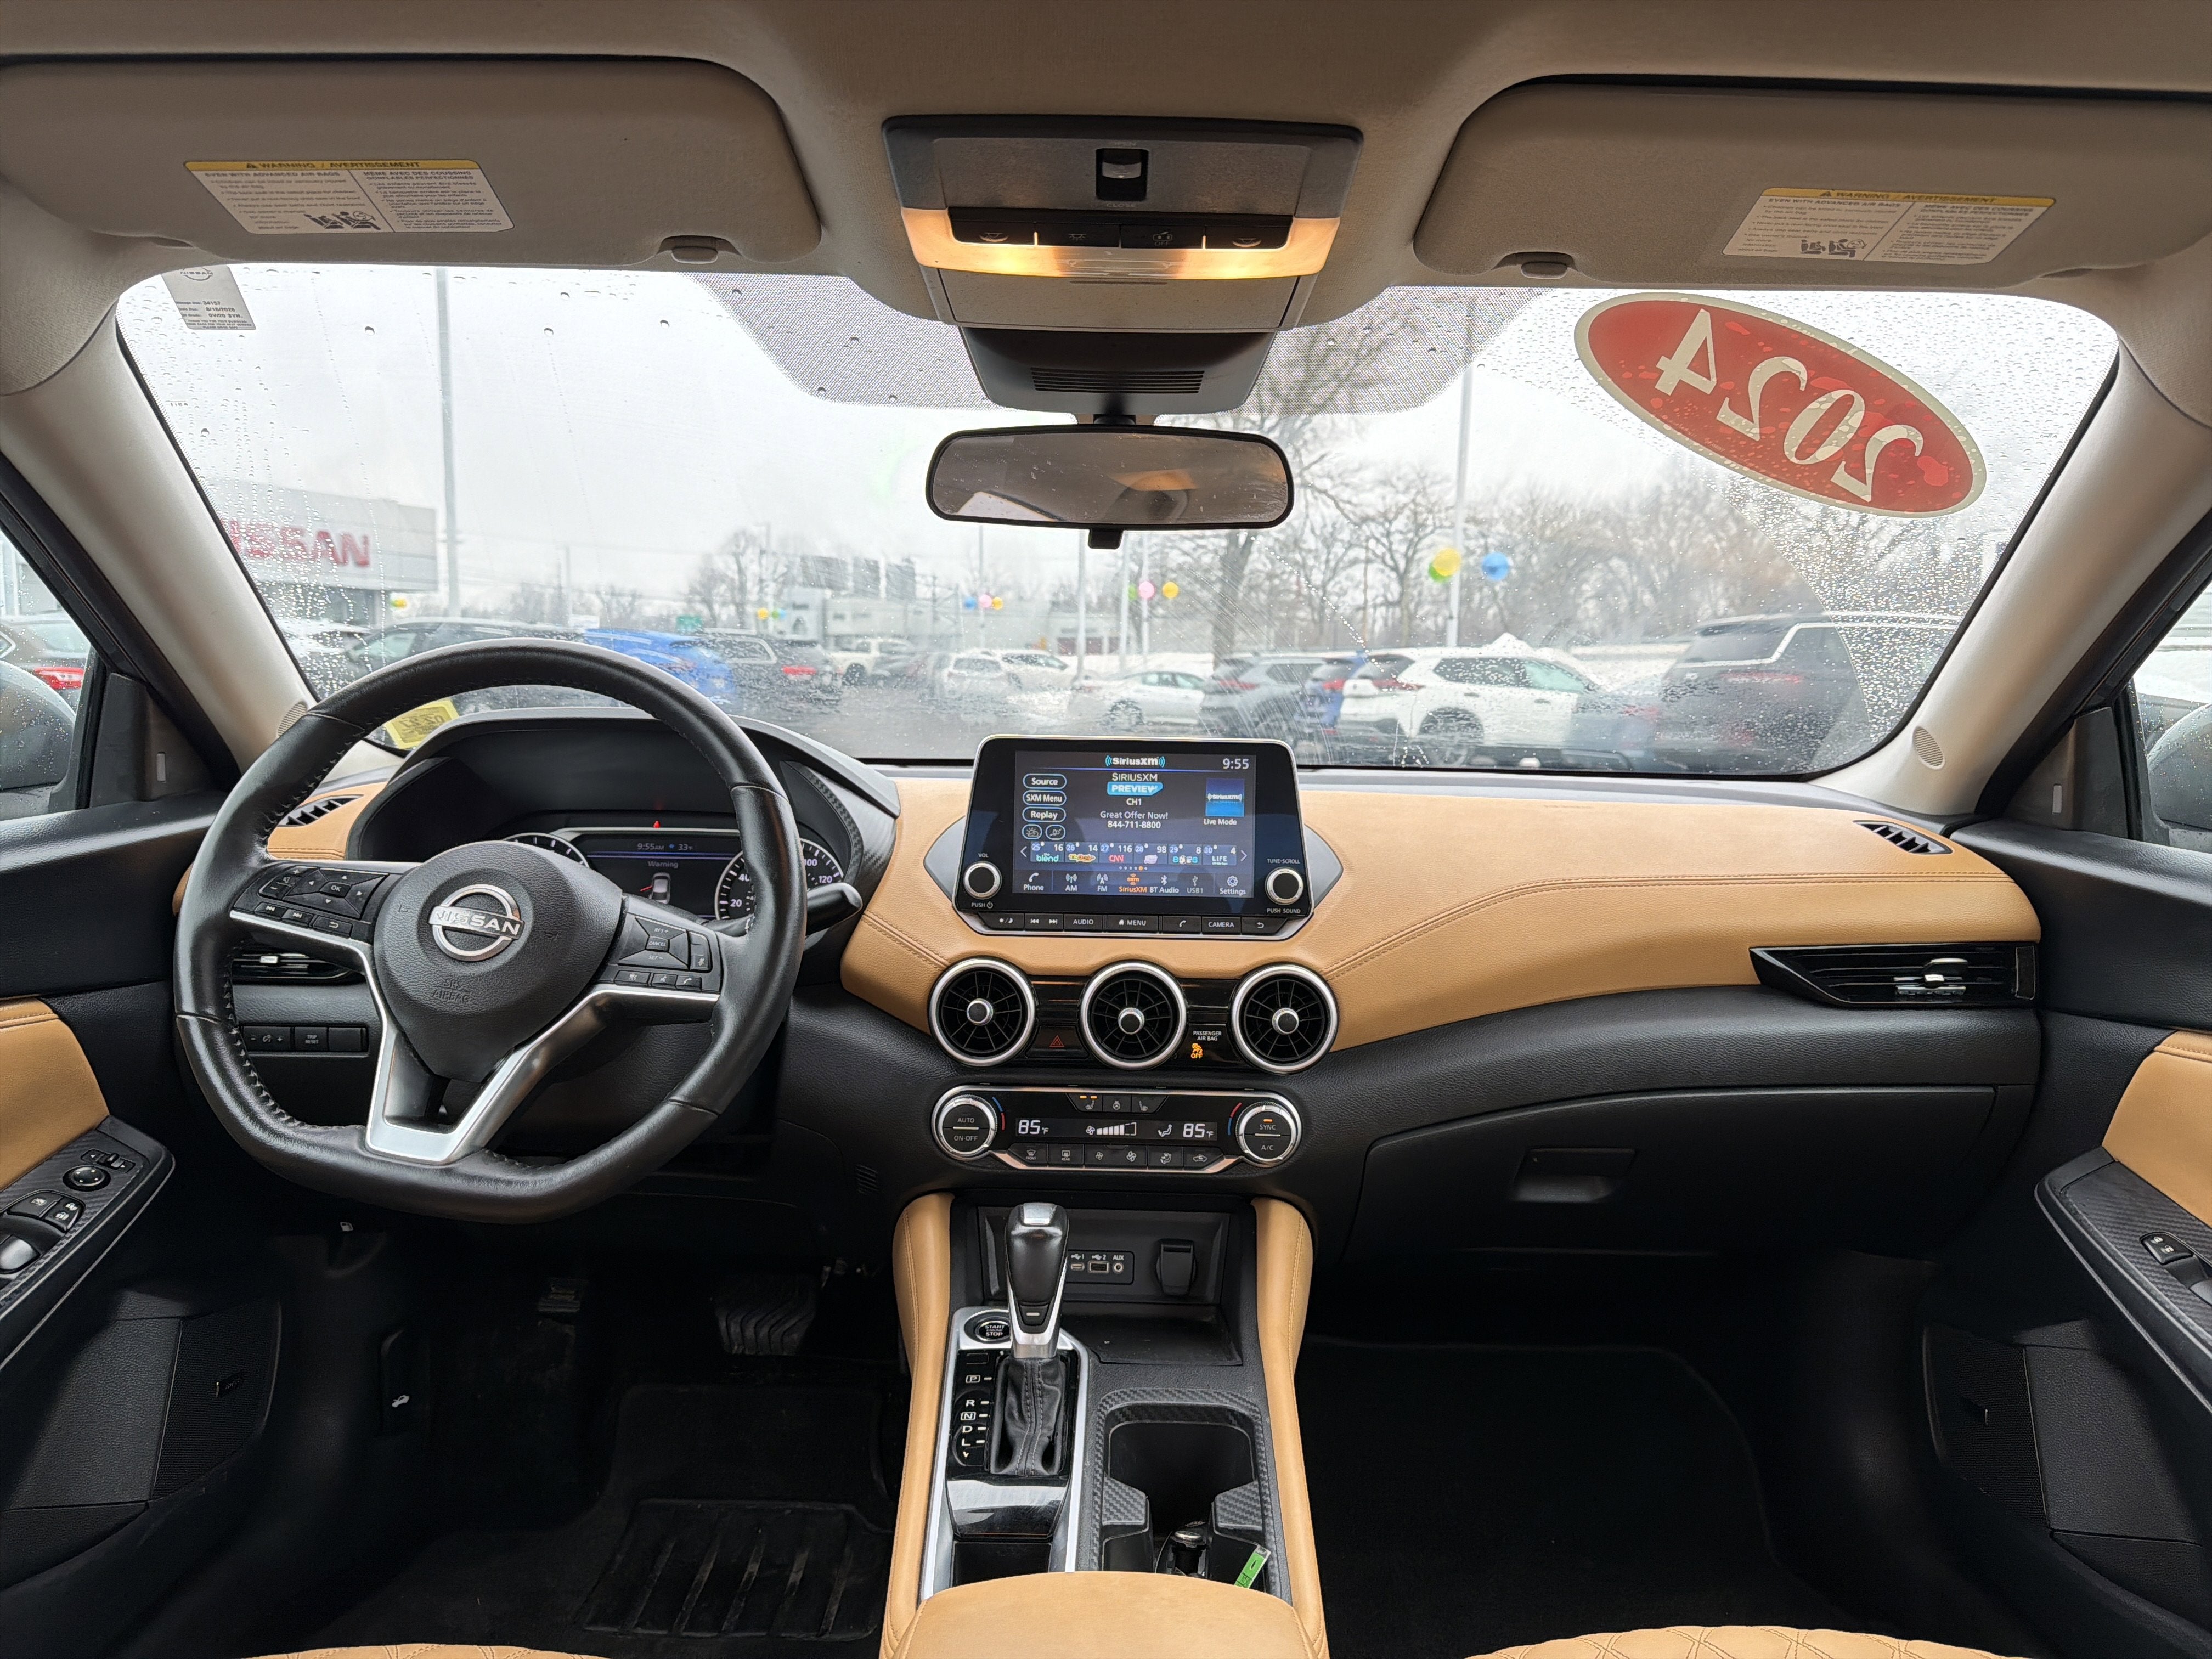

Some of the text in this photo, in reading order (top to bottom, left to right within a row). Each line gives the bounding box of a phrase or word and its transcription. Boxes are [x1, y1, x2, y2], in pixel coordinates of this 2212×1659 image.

[221, 518, 370, 567] ISSAN
[1222, 758, 1250, 769] 9:55
[1031, 777, 1058, 786] Source
[1111, 772, 1158, 782] SIRIUSXM
[1126, 798, 1142, 806] CH1
[1030, 811, 1058, 821] Replay
[1100, 811, 1169, 820] Great Offer Now!
[1107, 821, 1161, 829] 844-711-8800
[1156, 845, 1167, 854] 98
[1036, 854, 1059, 862] blend
[648, 860, 679, 869] Warning
[1219, 888, 1246, 896] Settings
[730, 899, 742, 907] 20
[437, 910, 521, 935] NISSAN
[444, 978, 461, 989] SRS
